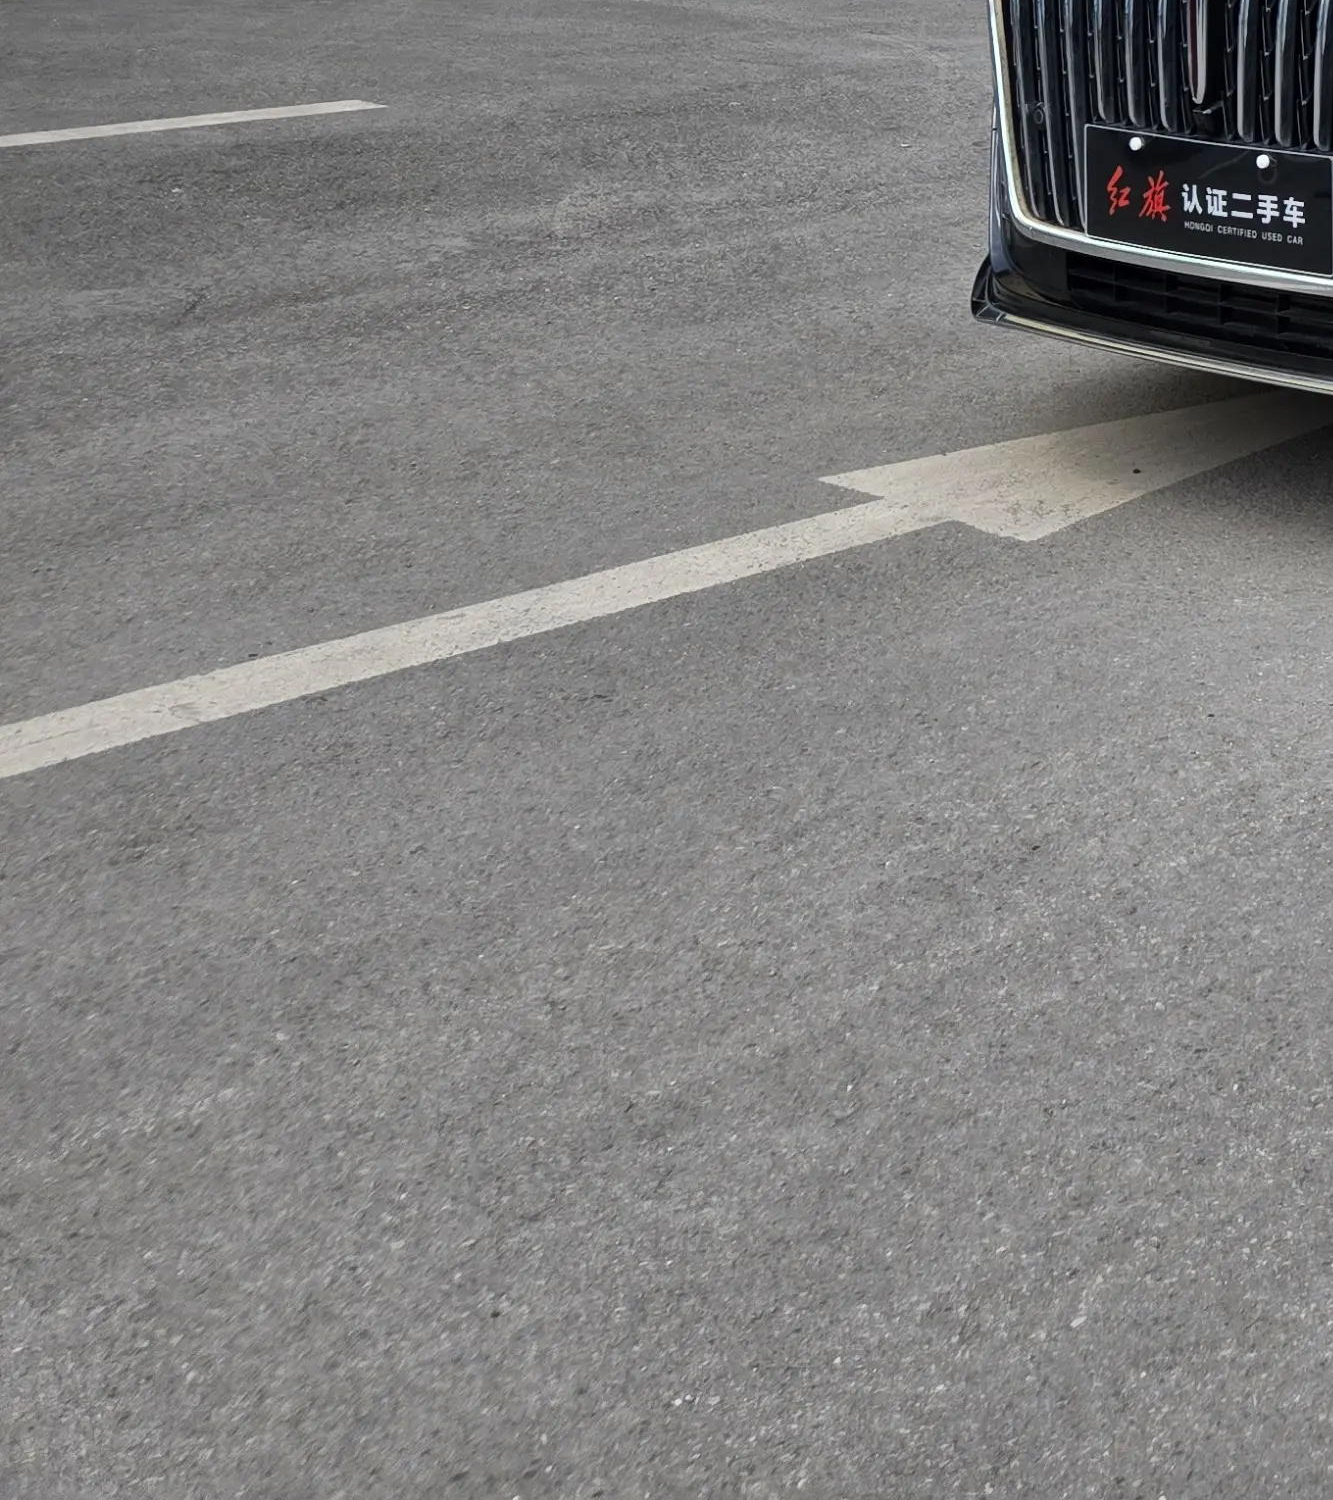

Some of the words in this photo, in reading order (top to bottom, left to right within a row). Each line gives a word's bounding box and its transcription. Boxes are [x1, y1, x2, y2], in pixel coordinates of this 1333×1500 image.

[1106, 165, 1171, 222] 红旗
[1181, 183, 1306, 229] 认证二手车
[1183, 220, 1214, 233] HONGQI
[1217, 224, 1258, 239] CERTIFIED
[1261, 231, 1283, 243] USED
[1286, 234, 1304, 246] CAR
